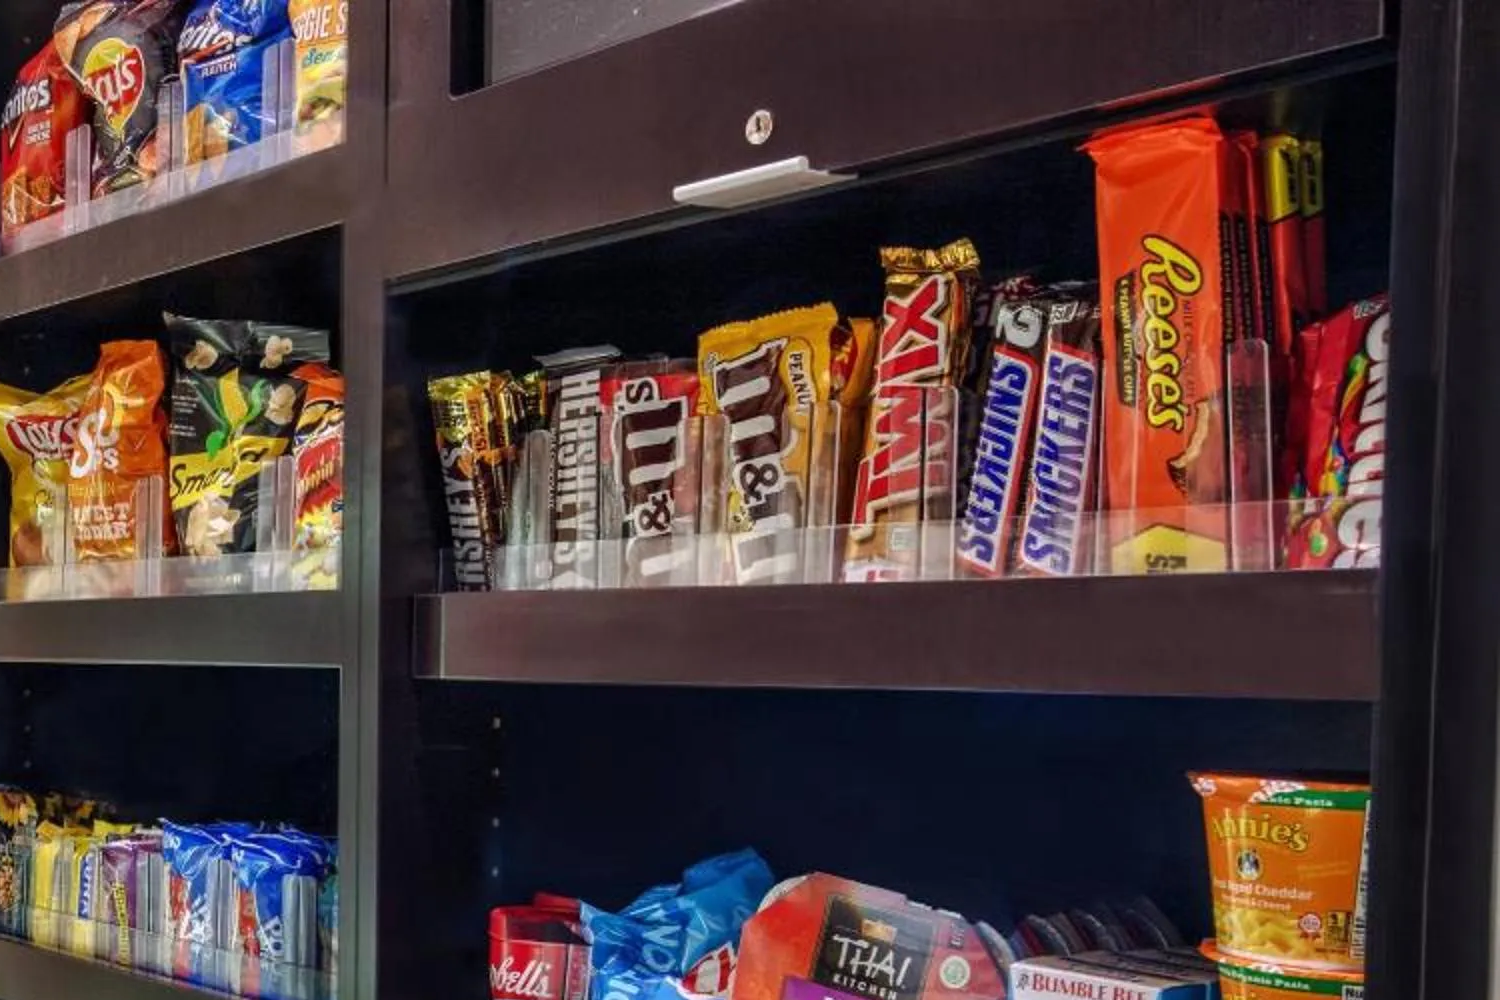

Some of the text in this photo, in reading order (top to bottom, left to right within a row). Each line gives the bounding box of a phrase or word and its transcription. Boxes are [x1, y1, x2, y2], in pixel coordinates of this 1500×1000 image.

[850, 272, 953, 541] TWIX
[1140, 234, 1203, 432] Reese's
[439, 446, 486, 588] RSHEY'S
[959, 356, 1035, 566] SNICKERS
[1021, 354, 1097, 575] SNICKERS
[833, 933, 912, 989] THAI
